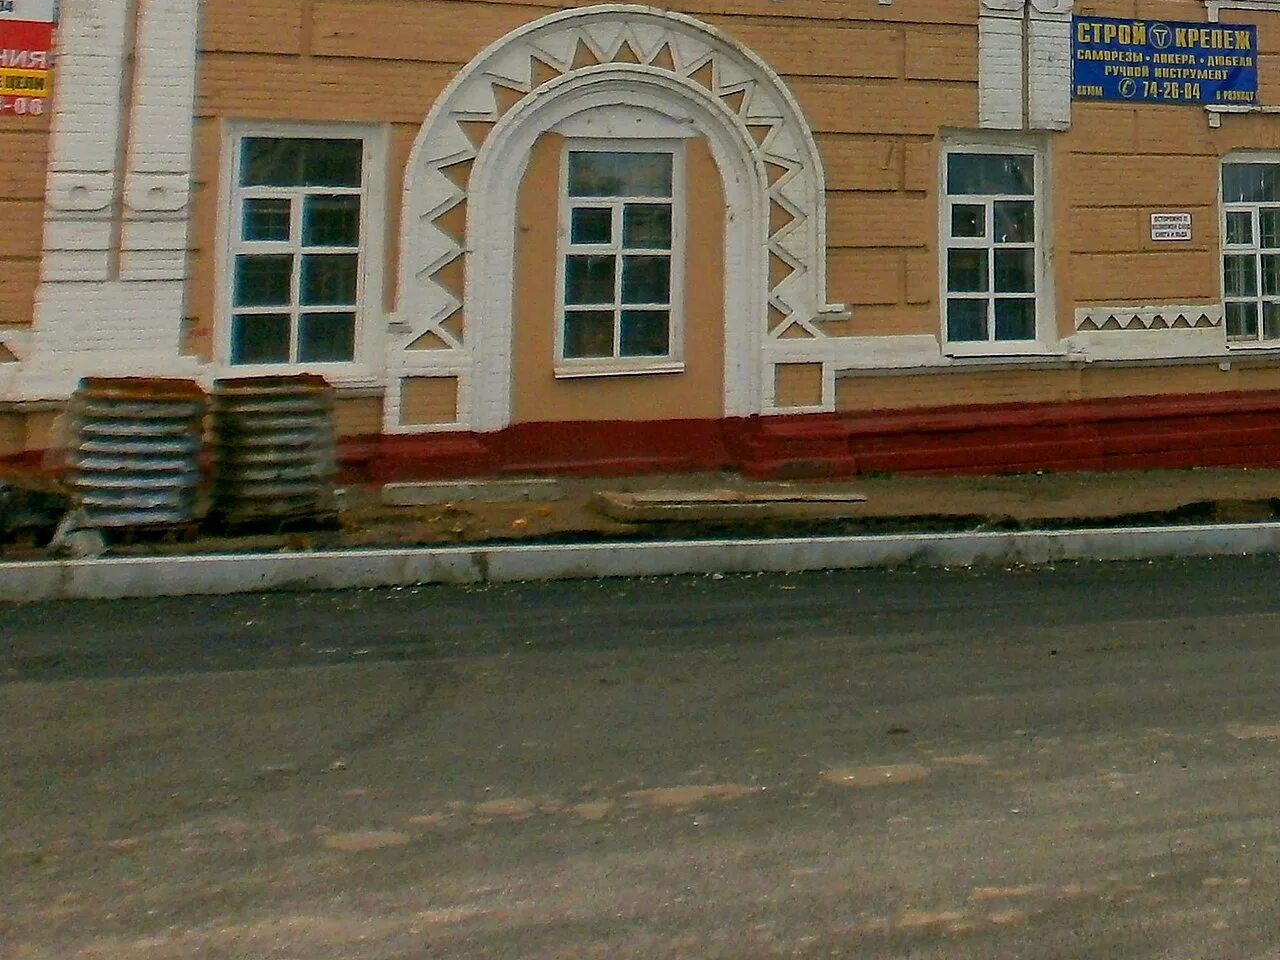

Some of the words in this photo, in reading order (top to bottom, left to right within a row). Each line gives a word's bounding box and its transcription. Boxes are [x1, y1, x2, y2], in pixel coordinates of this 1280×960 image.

[1077, 22, 1146, 45] СТРОЙ
[1175, 28, 1251, 50] КРЕПЕЖ
[1077, 50, 1143, 63] САМОРЕЗЫ
[1153, 54, 1196, 65] АНКЕРА
[1207, 56, 1253, 67] ДЮБЕЛЯ
[1104, 65, 1149, 77] РУЧНОЙ
[1154, 67, 1229, 80] ИНСТРУМЕНТ
[1143, 81, 1200, 99] 74-26-04
